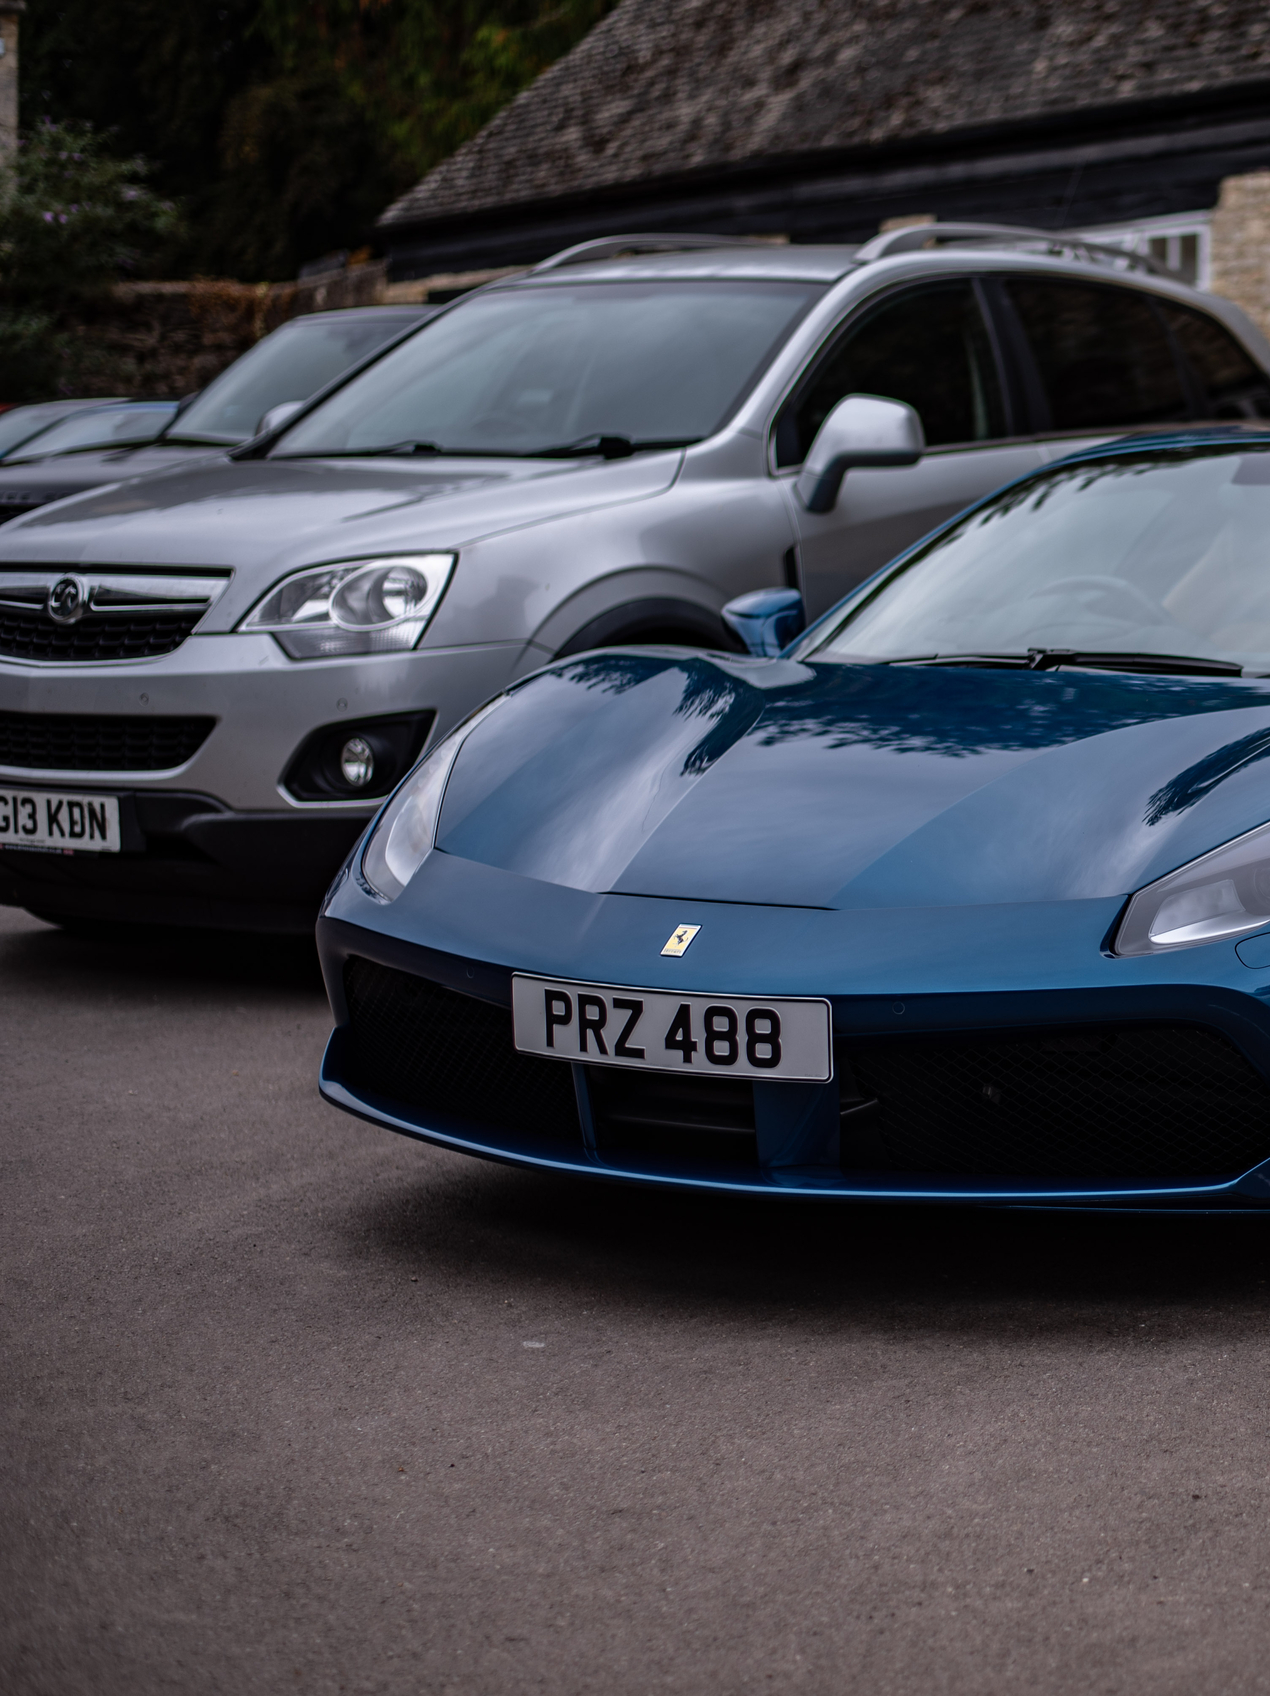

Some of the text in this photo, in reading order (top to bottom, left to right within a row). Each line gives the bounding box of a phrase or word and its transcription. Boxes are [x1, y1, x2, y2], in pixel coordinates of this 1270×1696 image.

[46, 798, 107, 841] KDN
[544, 987, 782, 1068] PRZ 488
